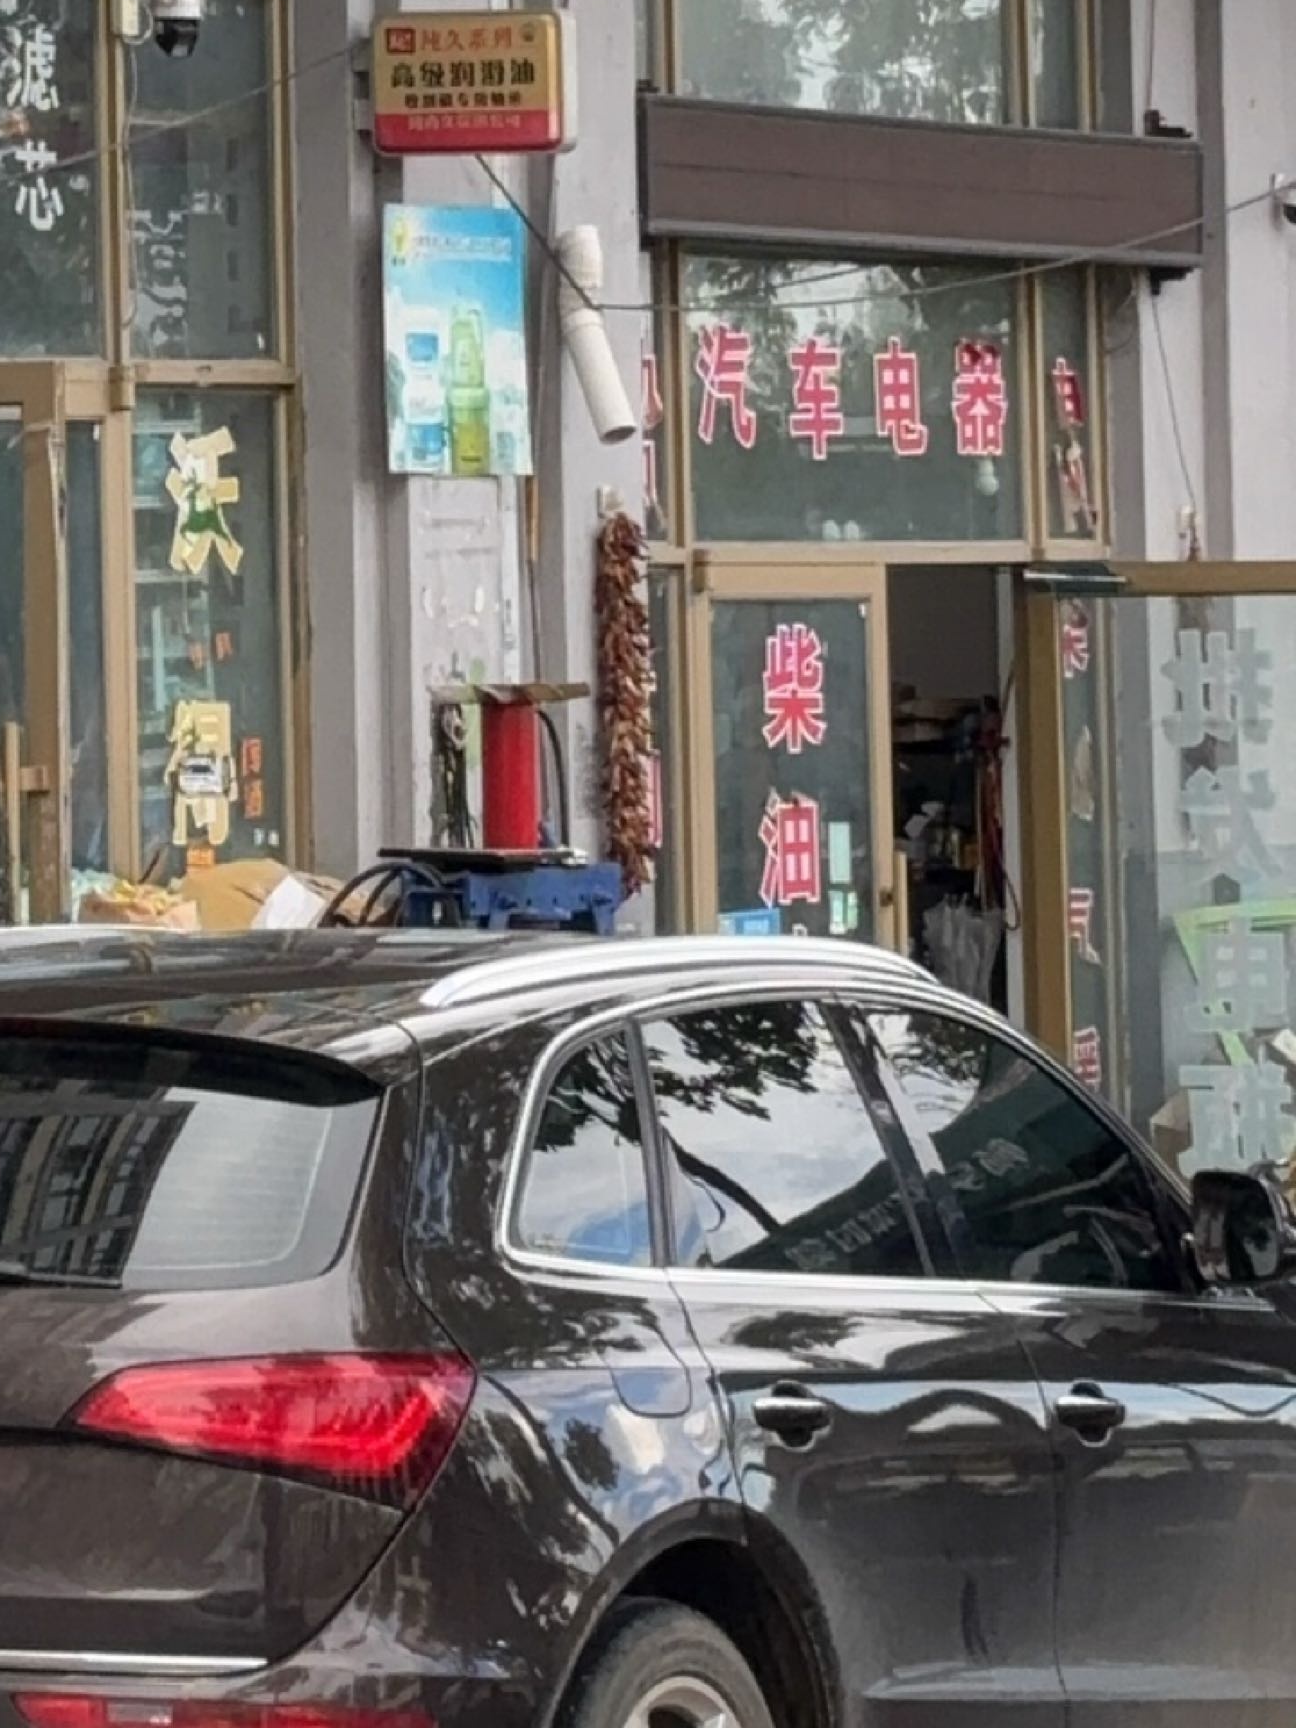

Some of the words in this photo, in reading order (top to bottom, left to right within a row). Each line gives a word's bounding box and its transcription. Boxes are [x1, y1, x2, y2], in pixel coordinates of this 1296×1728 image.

[3, 22, 65, 232] 滤芯
[391, 59, 535, 89] 高级润滑油
[697, 322, 1006, 460] 汽车电器
[759, 622, 827, 906] 柴油
